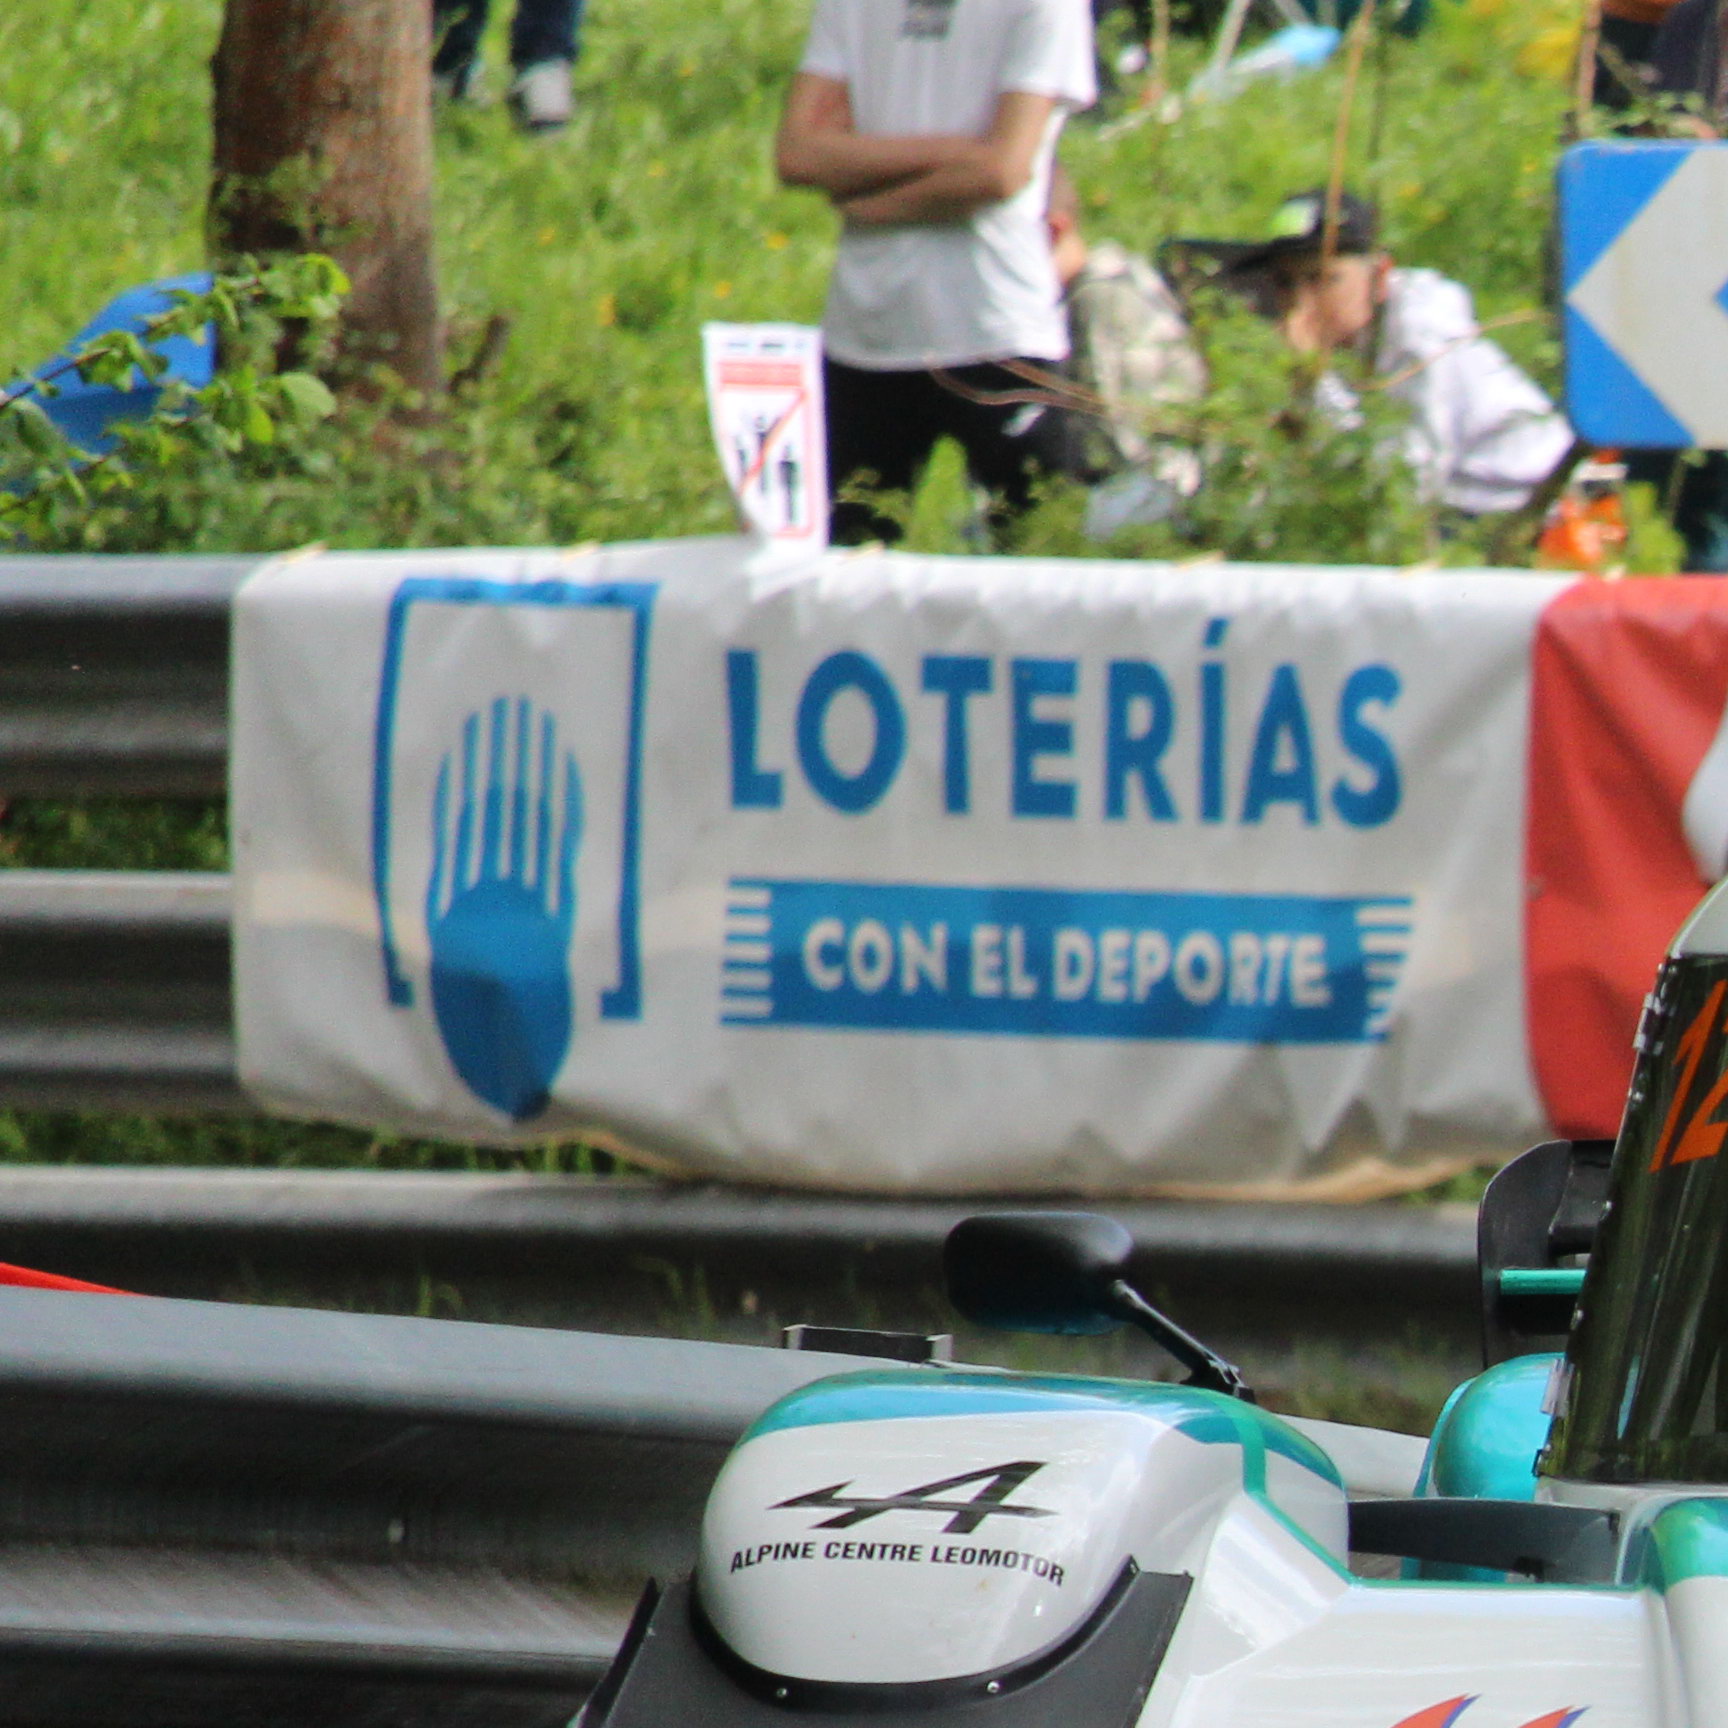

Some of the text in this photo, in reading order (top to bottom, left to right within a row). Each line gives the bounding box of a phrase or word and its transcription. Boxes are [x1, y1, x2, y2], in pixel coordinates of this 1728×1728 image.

[724, 616, 1404, 829] LOTERÍAS
[804, 917, 1332, 1010] CON EL DEPORTE
[730, 1541, 1066, 1588] ALPINE CENTRE LEOMOTOR
